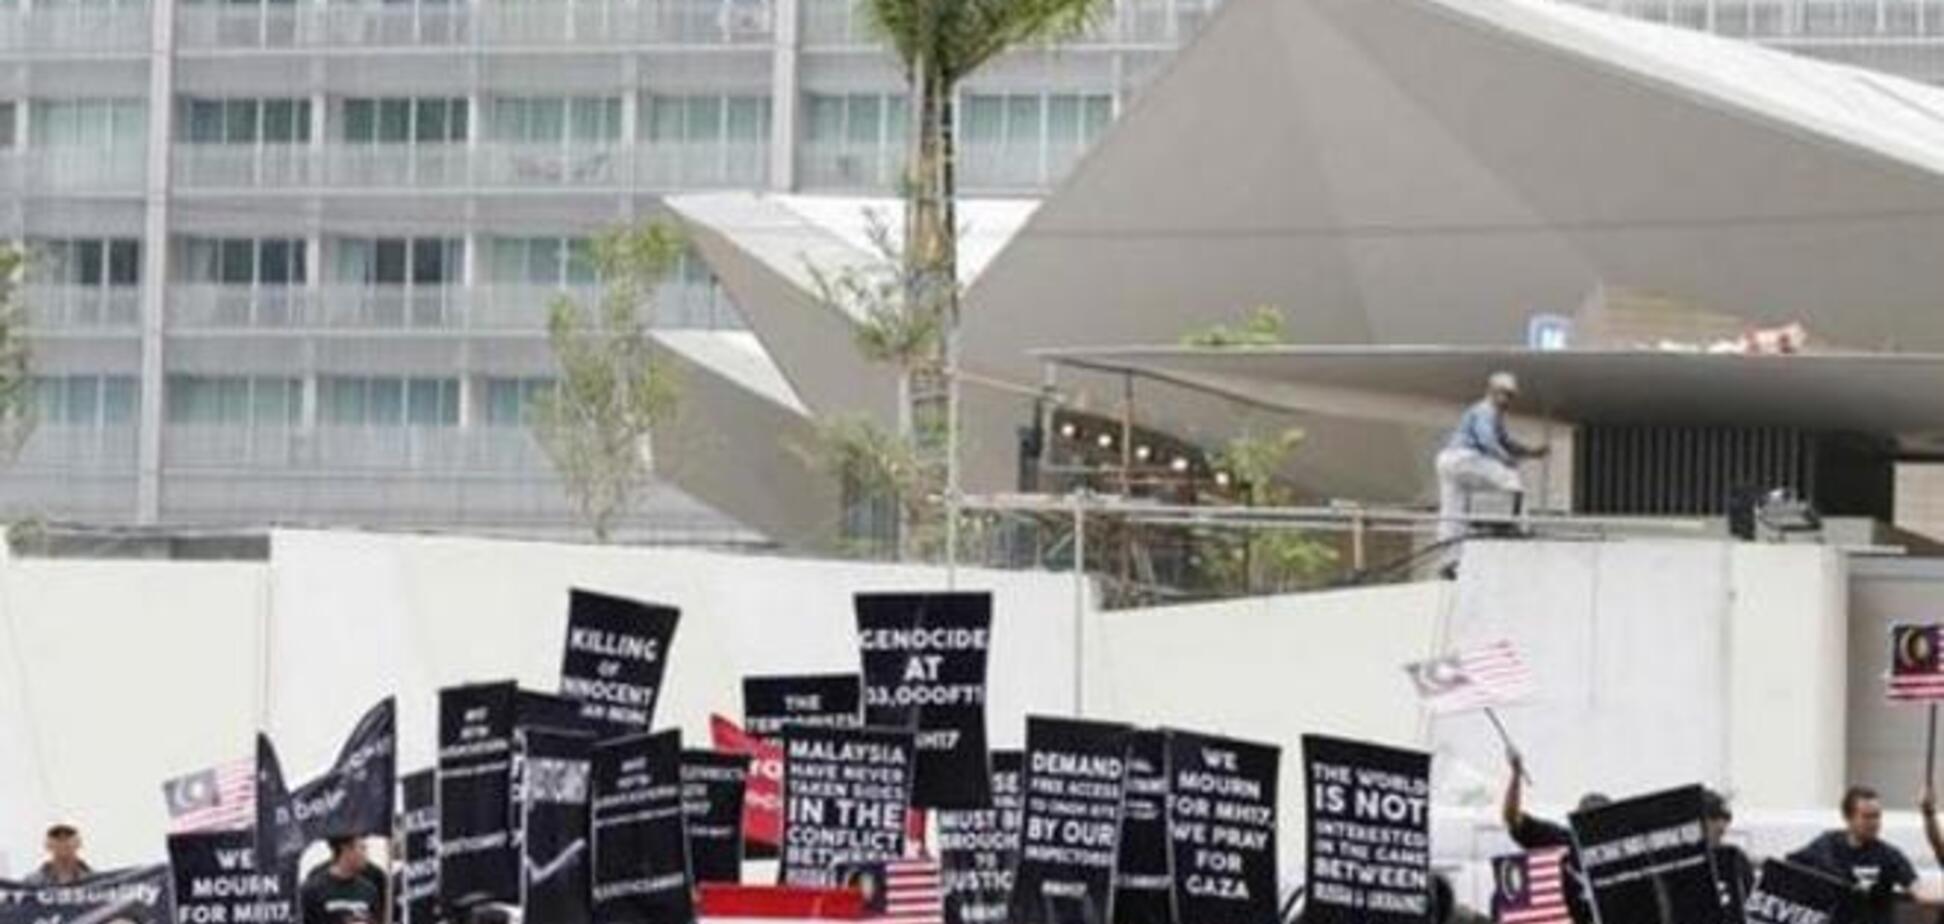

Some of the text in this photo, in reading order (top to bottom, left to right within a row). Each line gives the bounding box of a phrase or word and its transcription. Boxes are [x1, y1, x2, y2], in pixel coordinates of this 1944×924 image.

[571, 627, 658, 662] KILLING
[861, 628, 988, 650] GENOCIDE
[904, 655, 943, 681] AT
[789, 740, 905, 764] MALAYSIA
[1202, 748, 1238, 771] WE
[790, 763, 903, 783] HAVE NEVER
[1032, 752, 1123, 779] DEMAND
[790, 780, 847, 797] TAKEN
[1178, 771, 1261, 799] MOURN
[1312, 762, 1428, 796] THE WORLD
[789, 797, 823, 824] IN
[836, 799, 903, 830] THE
[1166, 794, 1209, 817] FOR
[1315, 783, 1427, 825] IS NOT
[787, 825, 898, 851] CONFLICT
[1028, 816, 1115, 846] BY OUR
[1169, 819, 1268, 850] WE PRAY
[1315, 820, 1428, 848] INTERESTED
[216, 848, 254, 869] WE
[1196, 850, 1242, 872] FOR
[192, 874, 279, 897] MOURN
[944, 869, 1014, 892] JUSTIC
[1314, 856, 1427, 890] BETWEEN
[1186, 873, 1250, 900] GAZA
[178, 902, 228, 923] FOR
